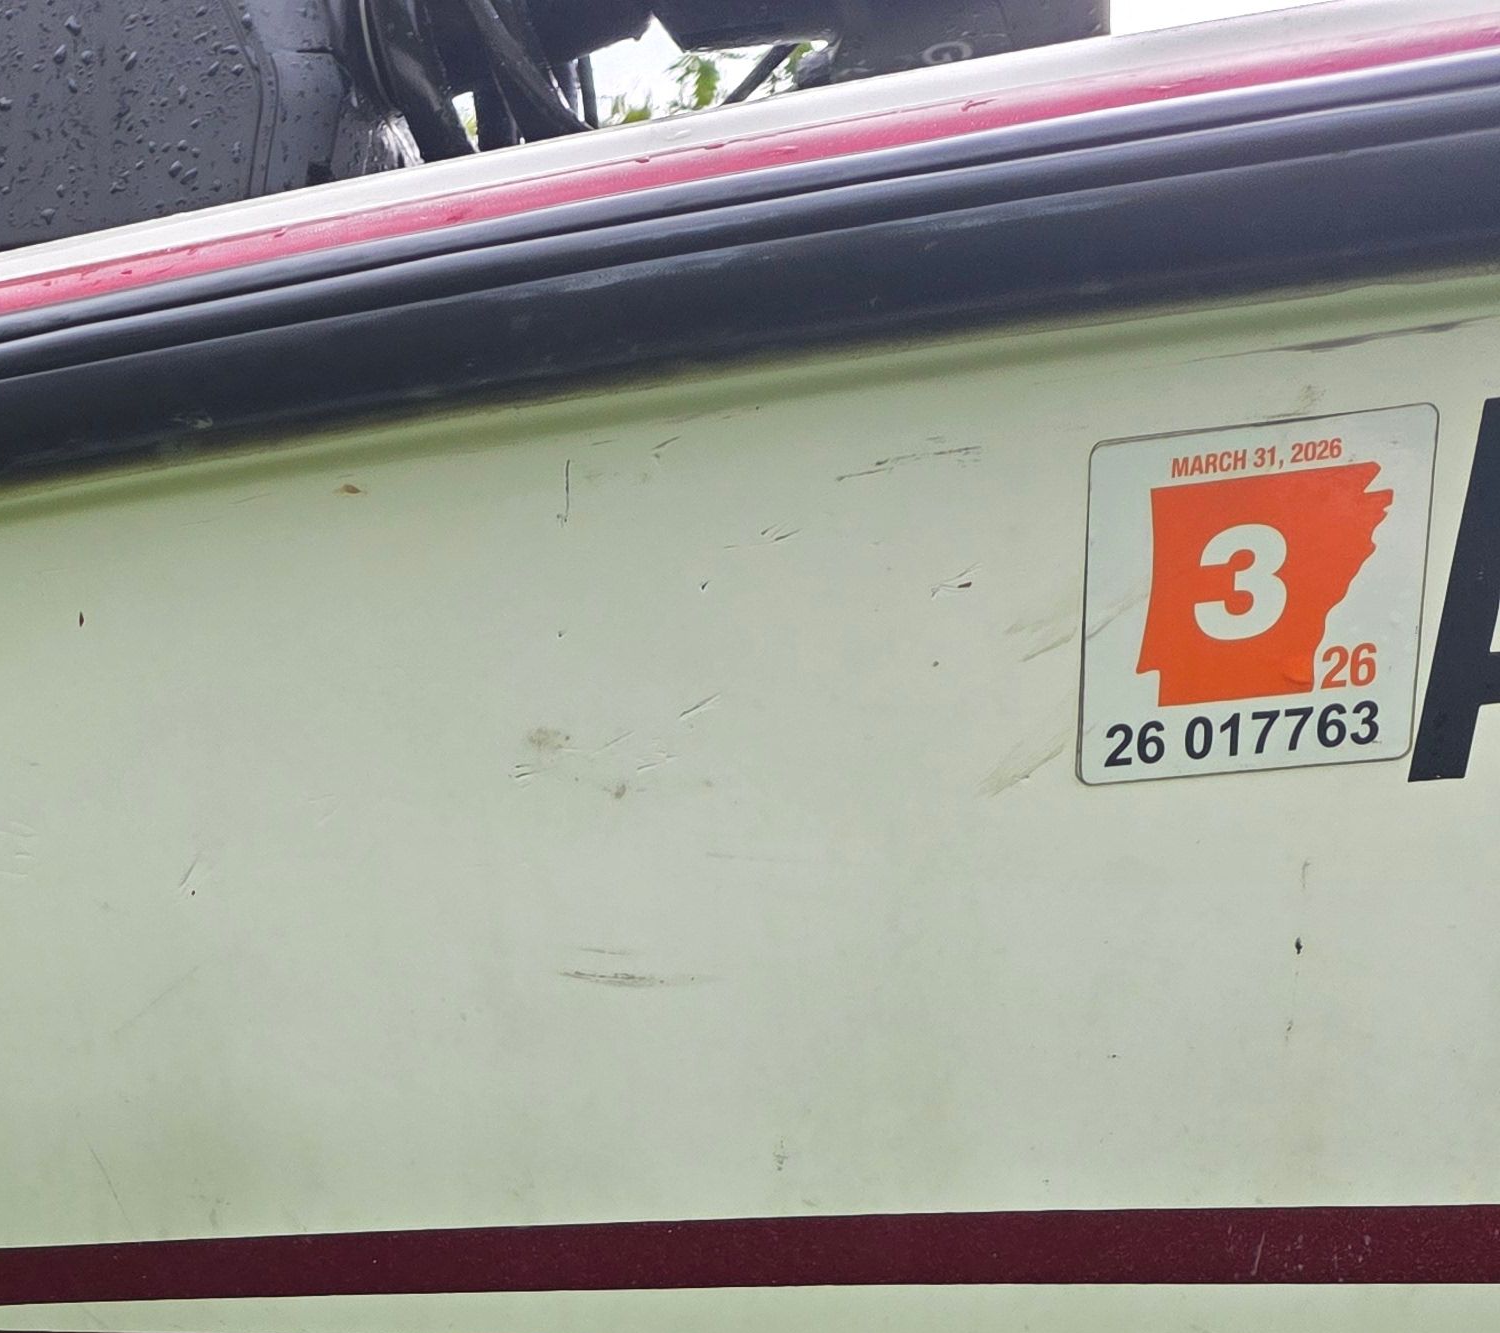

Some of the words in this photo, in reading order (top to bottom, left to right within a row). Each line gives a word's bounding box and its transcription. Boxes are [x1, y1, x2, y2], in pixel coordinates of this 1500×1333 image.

[1171, 449, 1248, 479] MARCH
[1253, 445, 1284, 471] 31,
[1291, 437, 1343, 464] 2026
[1194, 523, 1288, 640] 3
[1320, 642, 1377, 690] 26
[1104, 720, 1165, 768] 26
[1184, 700, 1380, 760] 017763
